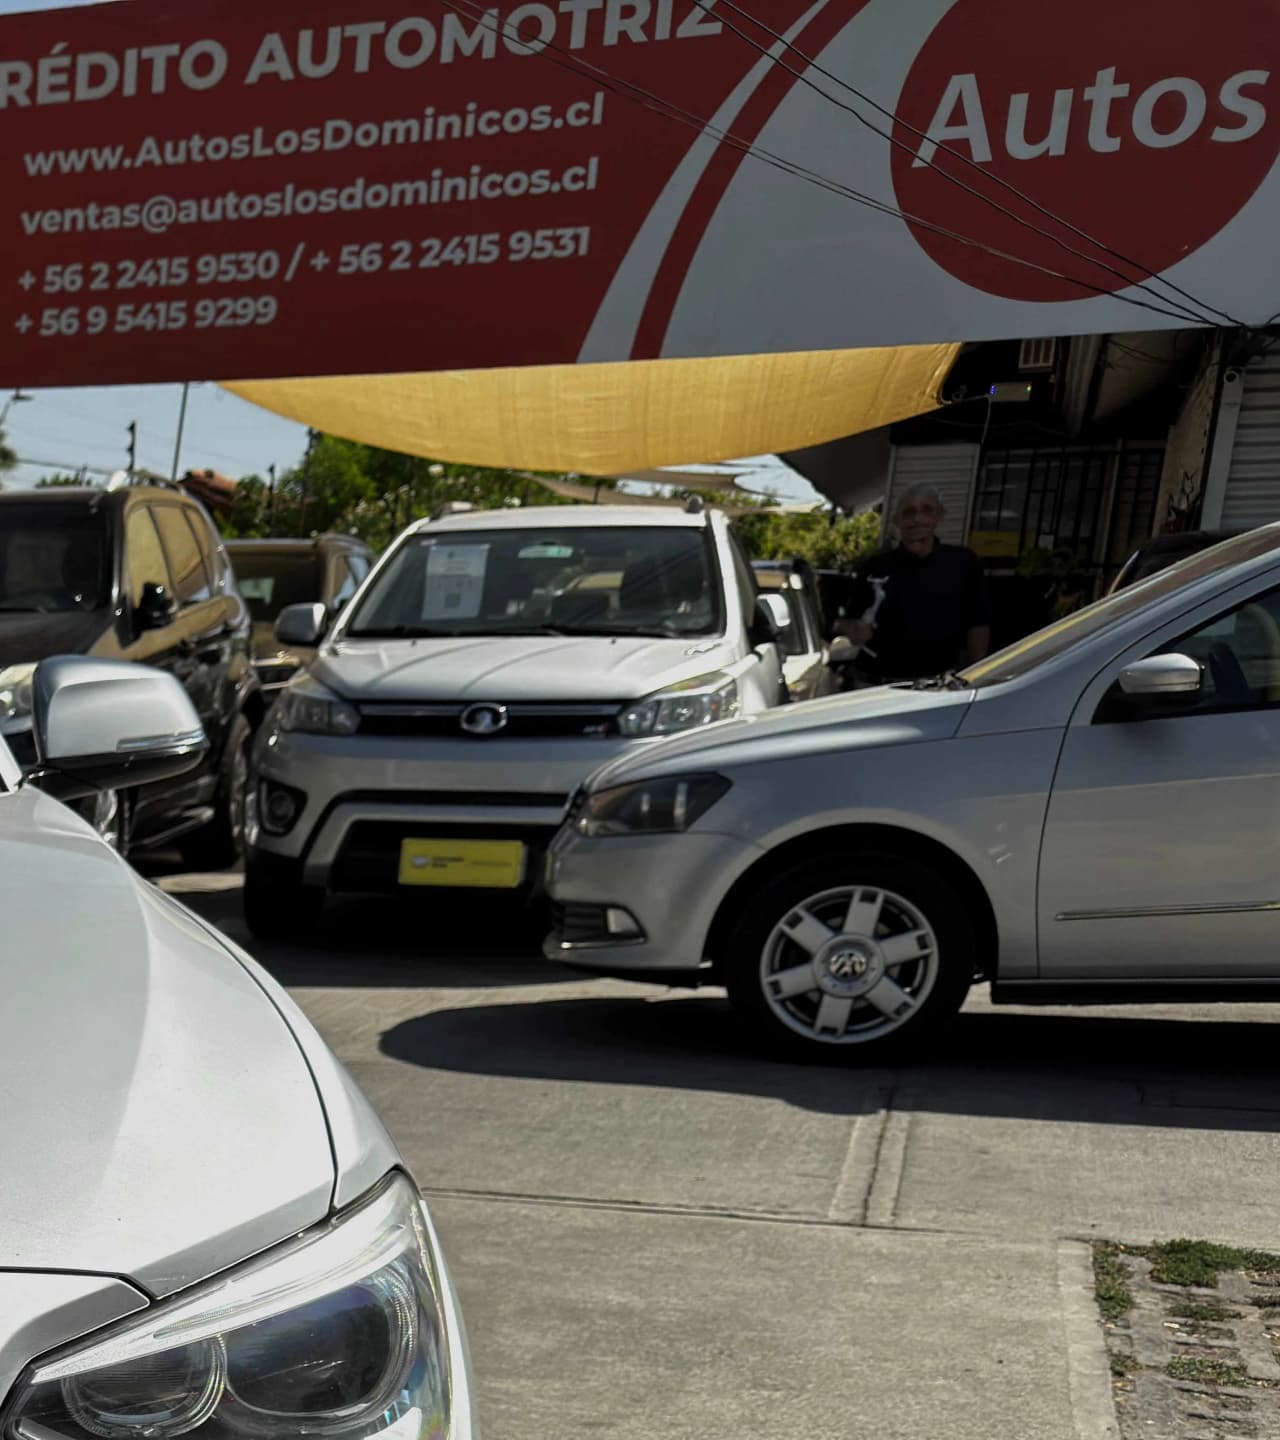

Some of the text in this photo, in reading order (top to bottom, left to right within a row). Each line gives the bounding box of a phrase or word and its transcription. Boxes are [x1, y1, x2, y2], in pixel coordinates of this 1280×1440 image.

[244, 0, 724, 84] AUTOMOTRIZ
[24, 92, 604, 176] www.AutosLosDominicos.cl
[912, 66, 1271, 168] Autos
[21, 156, 599, 235] ventas@autoslosdominicos.cl
[18, 269, 36, 291] +
[42, 263, 83, 293] 56
[90, 262, 110, 290] 2
[115, 256, 189, 289] 2415
[196, 250, 279, 284] 9530
[310, 251, 330, 272] +
[338, 243, 383, 274] 56
[389, 240, 412, 270] 2
[419, 233, 500, 268] 2415
[508, 226, 590, 261] 9531
[15, 295, 277, 337] + 56 9 5415 9299
